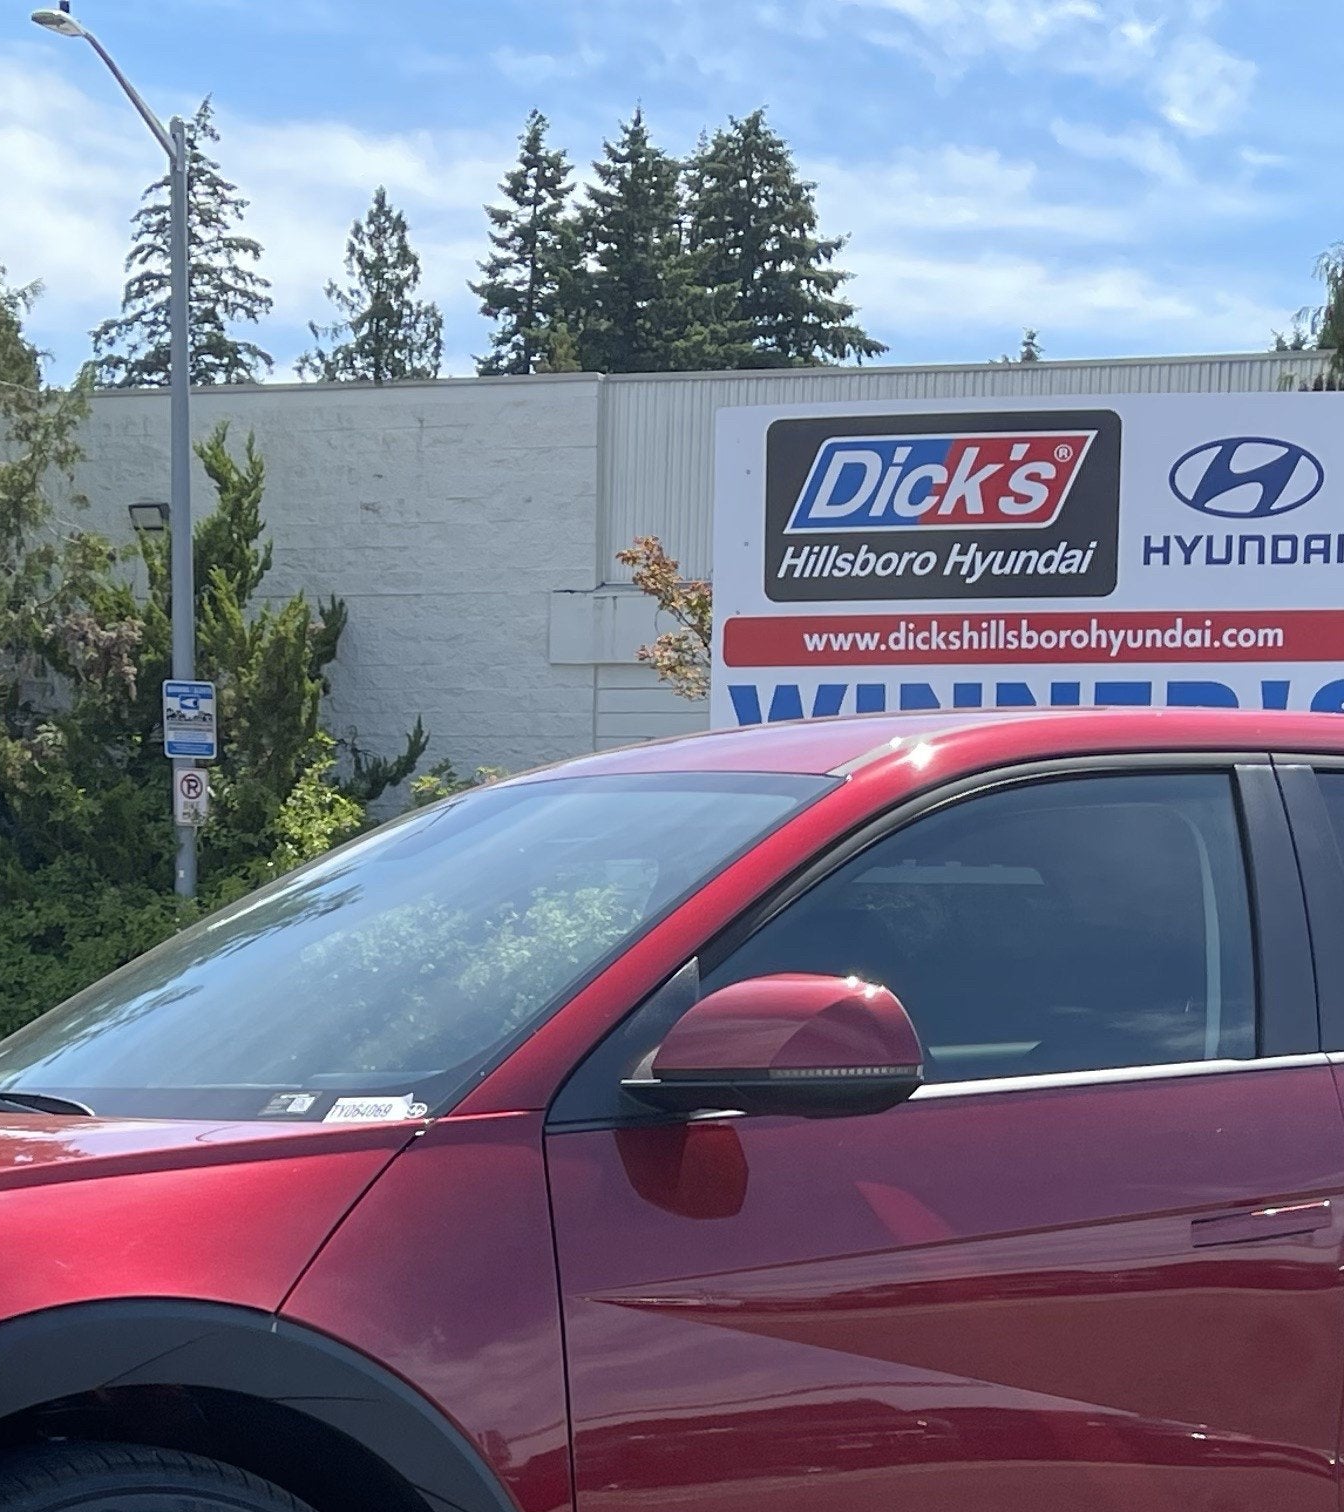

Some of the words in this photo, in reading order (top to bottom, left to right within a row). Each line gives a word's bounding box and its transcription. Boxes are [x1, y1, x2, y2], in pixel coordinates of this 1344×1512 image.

[807, 443, 1055, 520] Dick's
[778, 545, 936, 578] Hillsboro
[943, 541, 1097, 583] Hyundai
[803, 619, 1284, 658] www.dickshillsborohyundai.com
